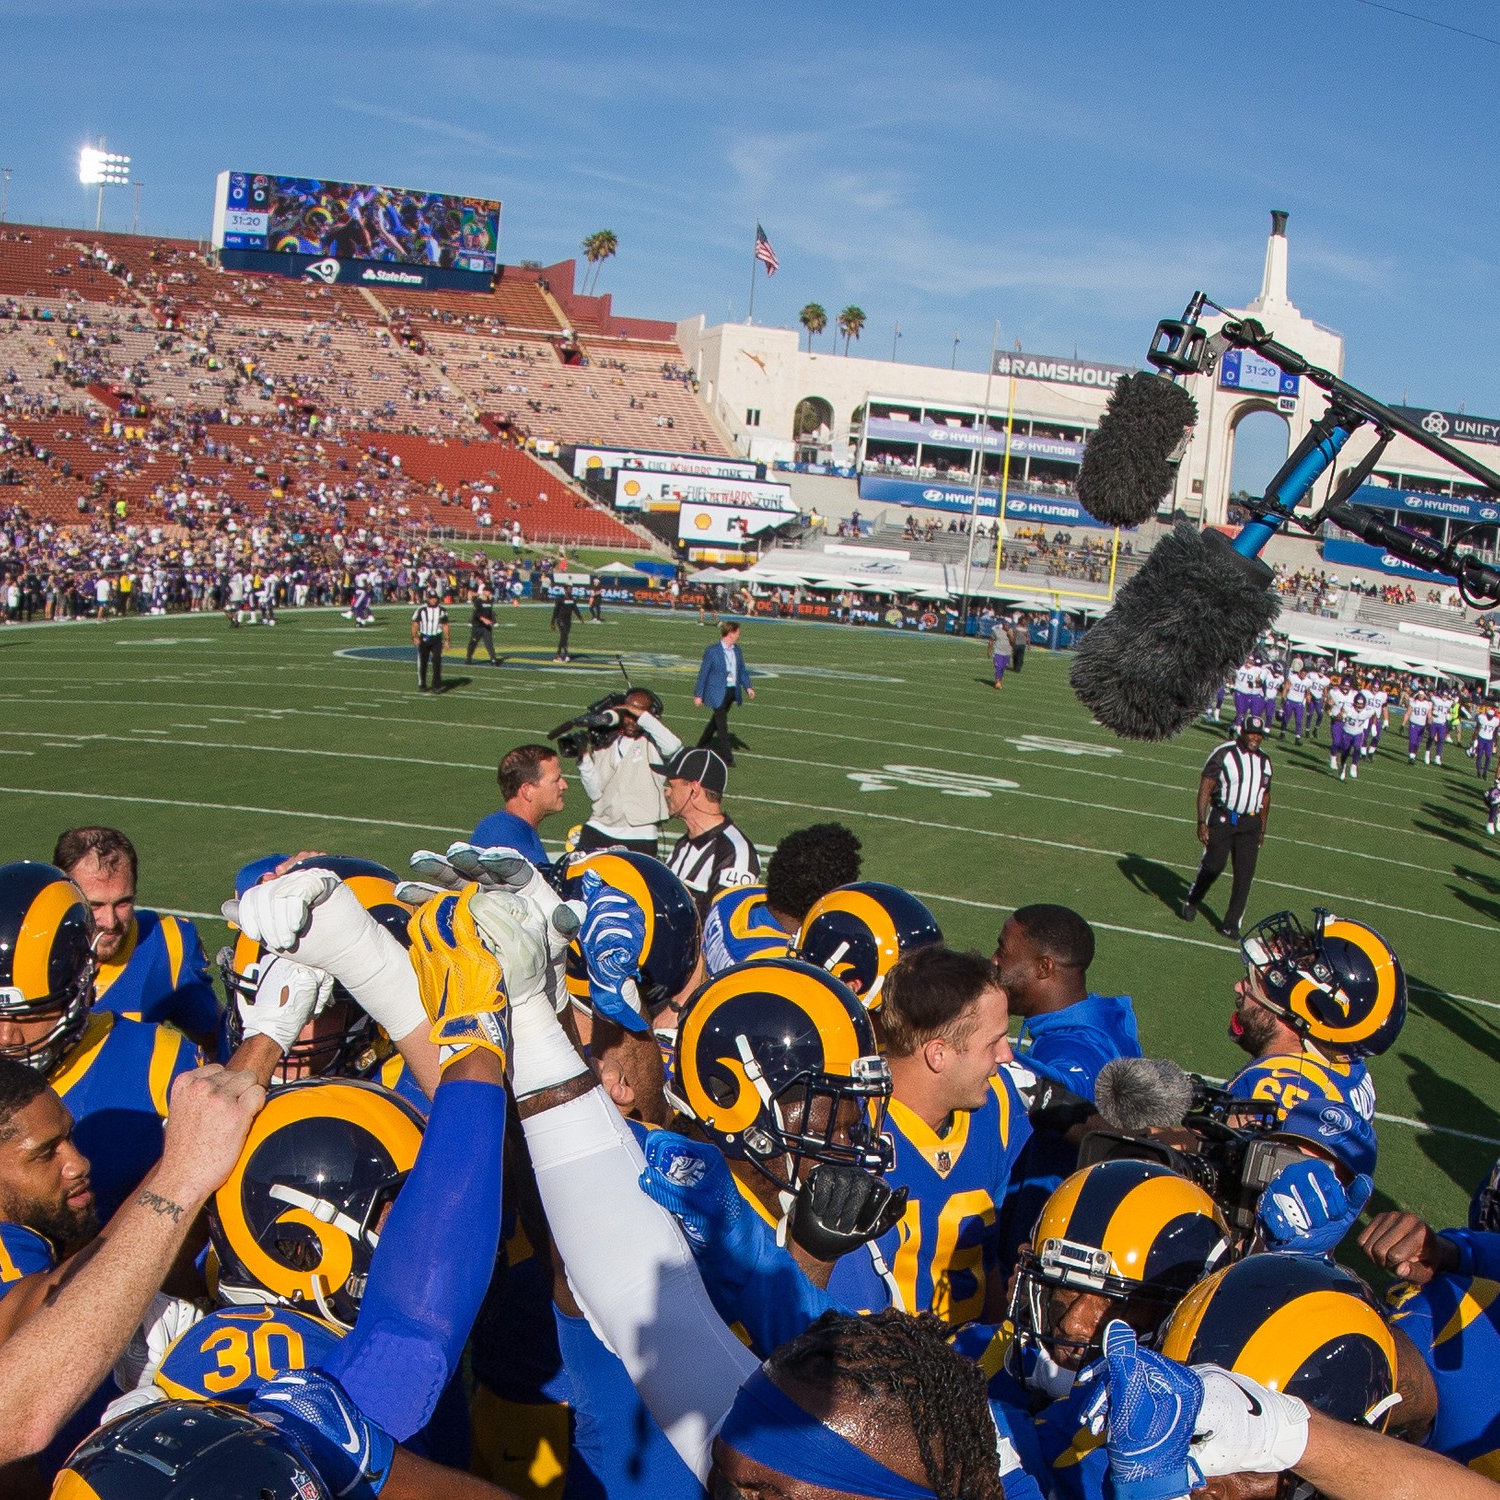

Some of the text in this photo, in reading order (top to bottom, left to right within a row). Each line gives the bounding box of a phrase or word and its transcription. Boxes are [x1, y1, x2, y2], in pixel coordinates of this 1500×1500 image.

[998, 357, 1130, 389] #RAMSHOUS
[1245, 363, 1277, 378] 31:20
[1455, 419, 1500, 438] UNIFY
[949, 432, 998, 447] HYUNDAI
[1027, 441, 1076, 457] HYUNDAI
[945, 492, 997, 508] HYUNDAI
[1423, 500, 1470, 515] HYUNDAI
[1028, 504, 1080, 519] HYUNDAI
[724, 872, 757, 887] 40
[199, 1322, 306, 1393] 30
